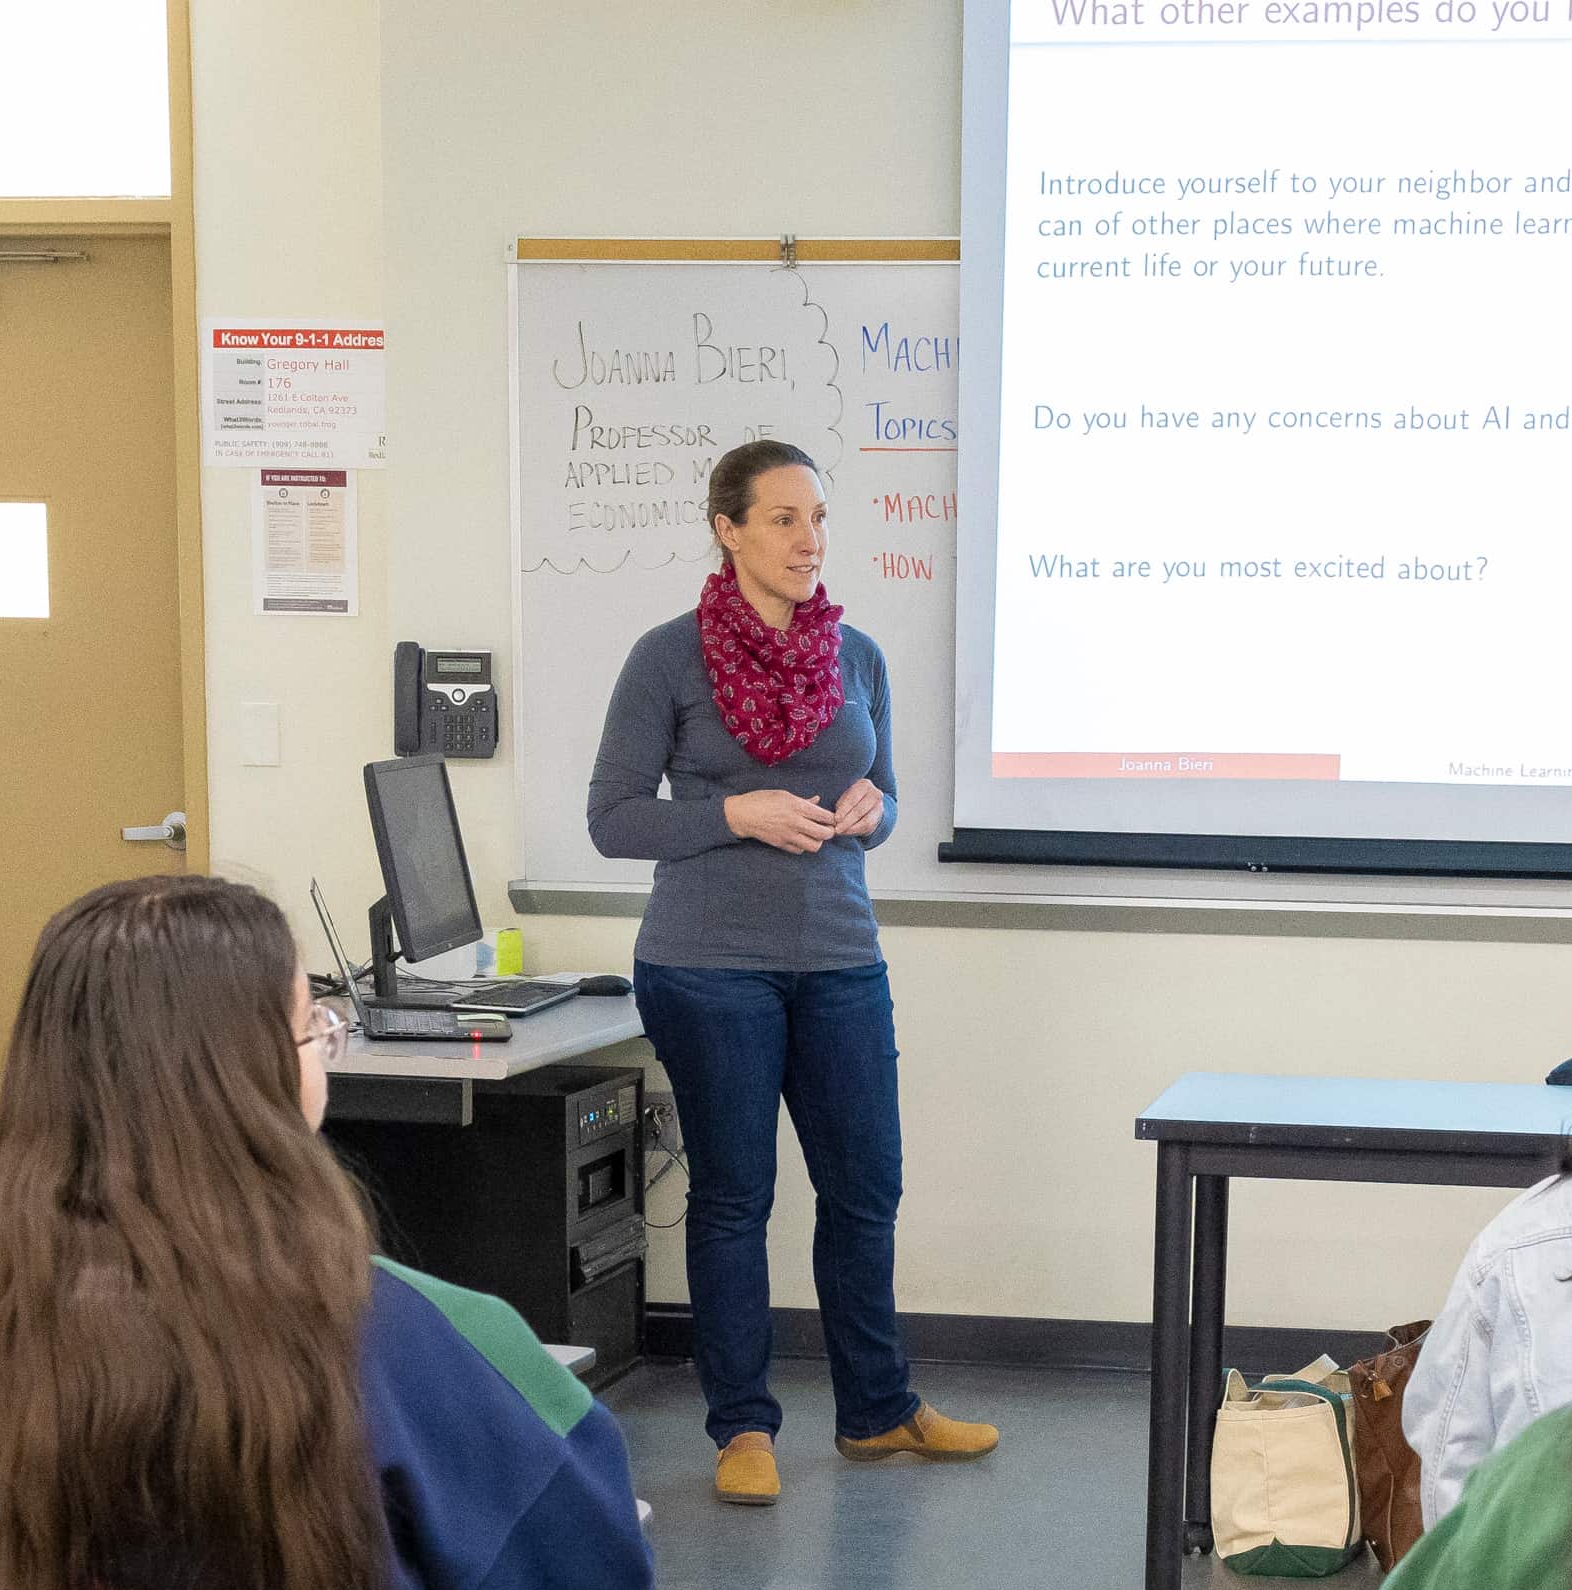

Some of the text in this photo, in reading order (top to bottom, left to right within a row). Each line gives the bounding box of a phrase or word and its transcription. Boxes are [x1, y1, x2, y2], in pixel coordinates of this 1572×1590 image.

[1051, 0, 1145, 27] What
[1160, 0, 1251, 25] other
[1264, 0, 1420, 32] examples
[1435, 0, 1477, 24] do
[1490, 0, 1550, 32] you
[1040, 169, 1166, 196] Introduce
[1176, 168, 1281, 201] yourself
[1289, 172, 1318, 194] to
[1327, 176, 1387, 200] your
[1398, 168, 1514, 201] neighbor
[1524, 167, 1572, 194] and
[1037, 219, 1082, 239] can
[1094, 210, 1124, 237] of
[1131, 209, 1202, 236] other
[1213, 209, 1293, 241] places
[1303, 209, 1382, 236] where
[1393, 209, 1504, 236] machine
[1036, 250, 1384, 284] current life or your future.
[221, 333, 261, 345] Know
[262, 334, 292, 346] Your
[295, 334, 329, 346] 9-1-1
[267, 359, 319, 372] Gregory
[324, 359, 349, 370] Hall
[268, 378, 291, 388] 176
[268, 394, 288, 402] 1261
[570, 405, 717, 451] PROFESSOR
[865, 400, 957, 441] TOPICS
[1033, 404, 1072, 430] Do
[1082, 411, 1128, 436] you
[1140, 403, 1200, 429] have
[1210, 411, 1257, 436] any
[1268, 409, 1382, 430] concerns
[1393, 404, 1470, 433] about
[1481, 404, 1510, 431] AI
[1522, 404, 1571, 433] and
[564, 460, 675, 489] APPLIED
[1028, 553, 1489, 585] What are you most excited about?
[1118, 757, 1214, 772] Joanna Bieri
[1448, 762, 1512, 778] Machine
